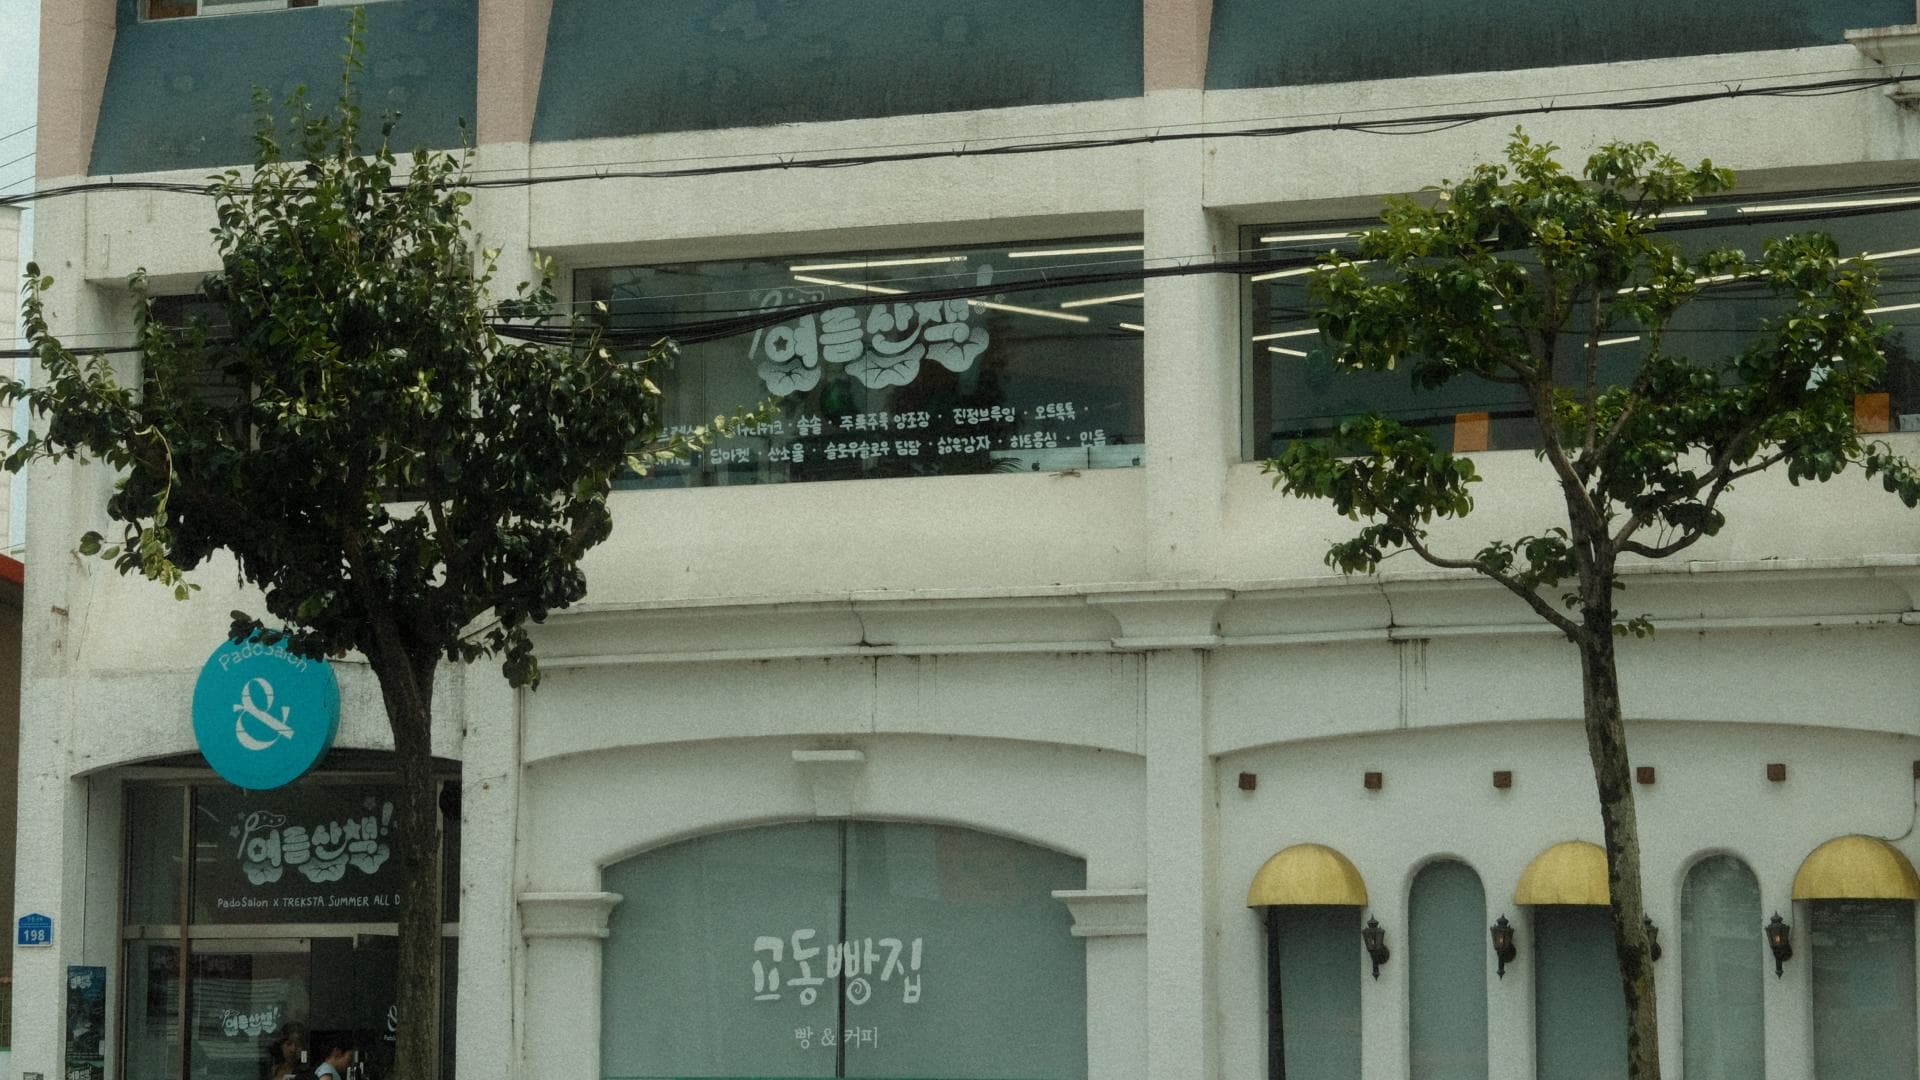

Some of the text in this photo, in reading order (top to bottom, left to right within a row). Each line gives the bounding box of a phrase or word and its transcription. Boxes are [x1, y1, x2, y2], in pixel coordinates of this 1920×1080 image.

[797, 413, 822, 436] 솔솔
[893, 411, 931, 430] 양조장
[952, 405, 1016, 425] 진정브루잉
[1034, 402, 1076, 421] 오트톡톡
[823, 440, 891, 461] 슬로우슬로우
[894, 440, 922, 456] 담담
[936, 435, 992, 455] 삶은감자
[1010, 431, 1058, 449] 하트옹심
[217, 896, 269, 908] PadoSalon
[283, 895, 325, 907] TREKSTA
[328, 895, 369, 907] SUMMER
[374, 894, 391, 906] ALL
[24, 929, 45, 942] 198
[752, 928, 923, 1006] 교동빵집
[794, 1026, 878, 1049] 빵 & 커피
